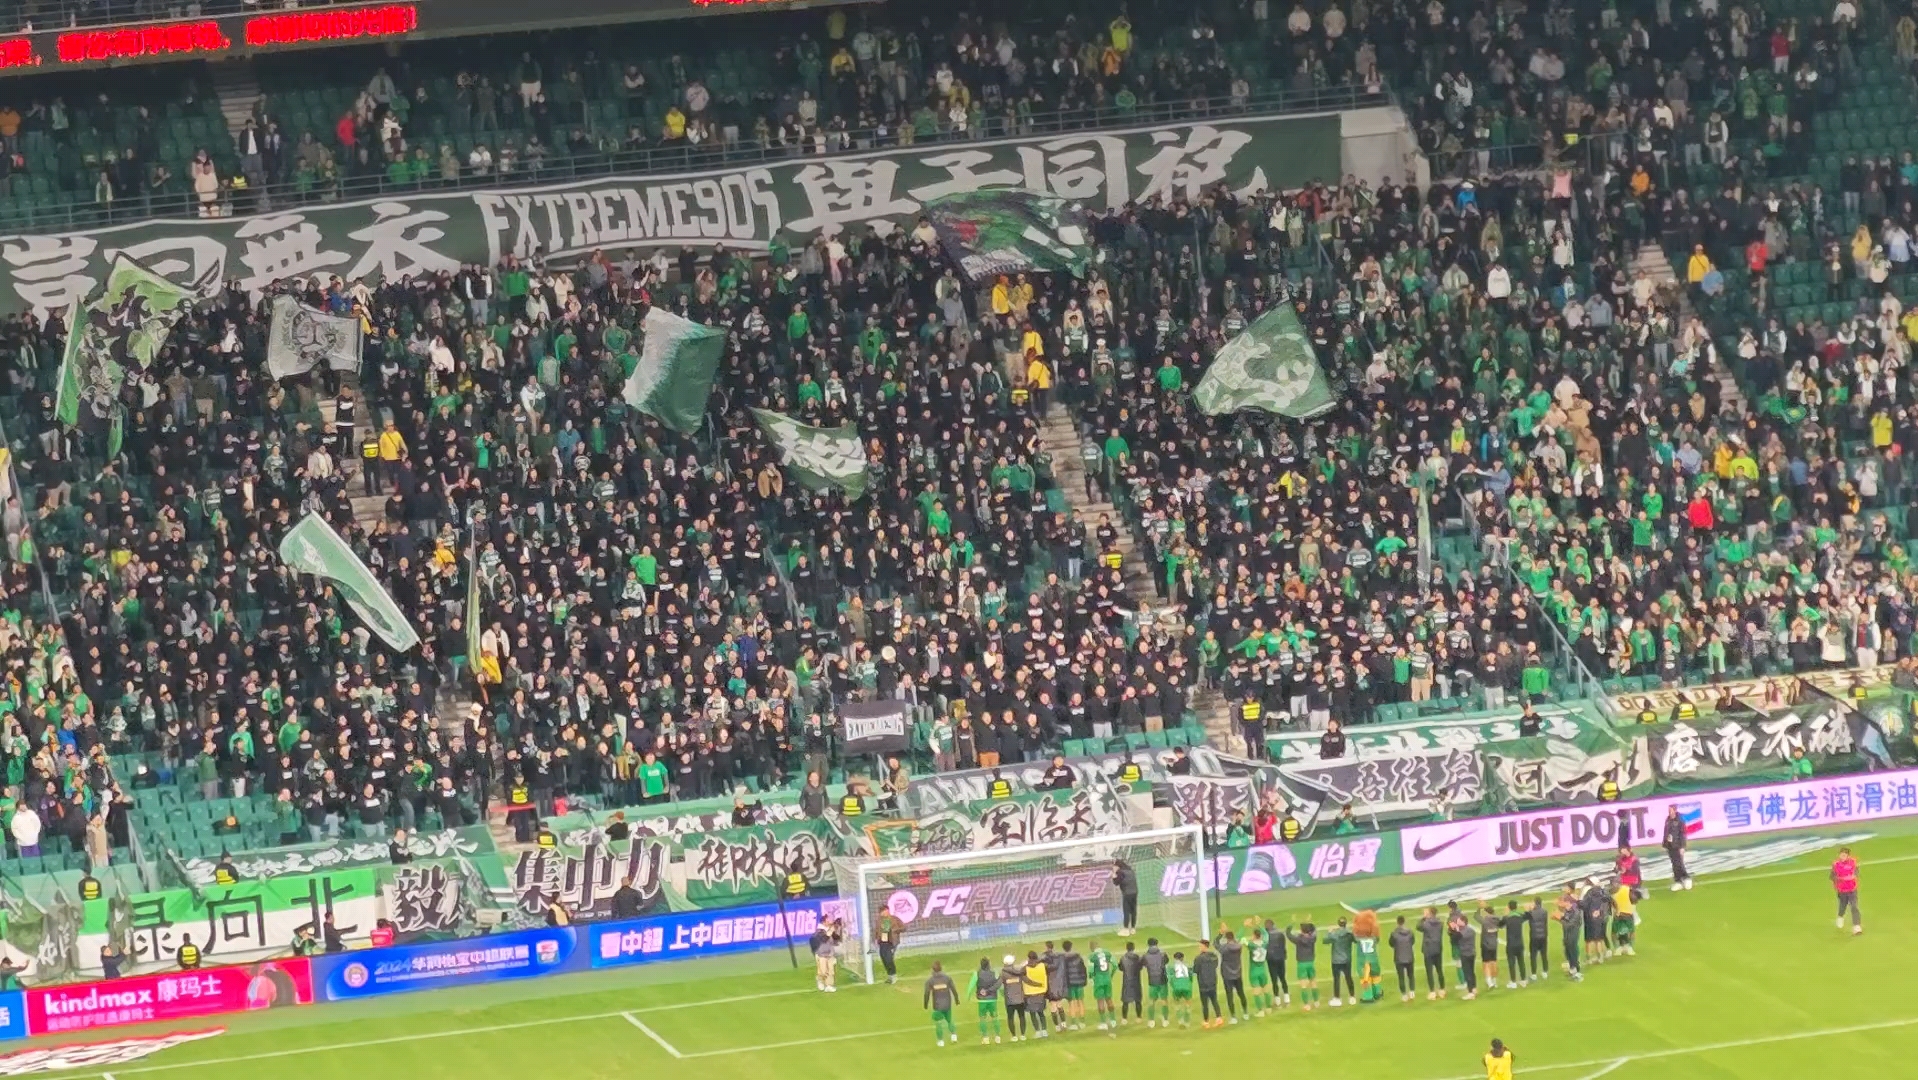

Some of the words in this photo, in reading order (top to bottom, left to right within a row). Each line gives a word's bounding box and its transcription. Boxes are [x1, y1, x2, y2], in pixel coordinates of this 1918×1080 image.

[1723, 778, 1917, 829] 雪佛龙润滑油
[1495, 815, 1563, 855] JUST
[1570, 810, 1617, 846] DO
[921, 885, 971, 918] FC
[965, 869, 1113, 912] FUTURES
[374, 958, 412, 976] 2024
[44, 988, 153, 1016] kindmax
[157, 974, 222, 1002] 康玛士
